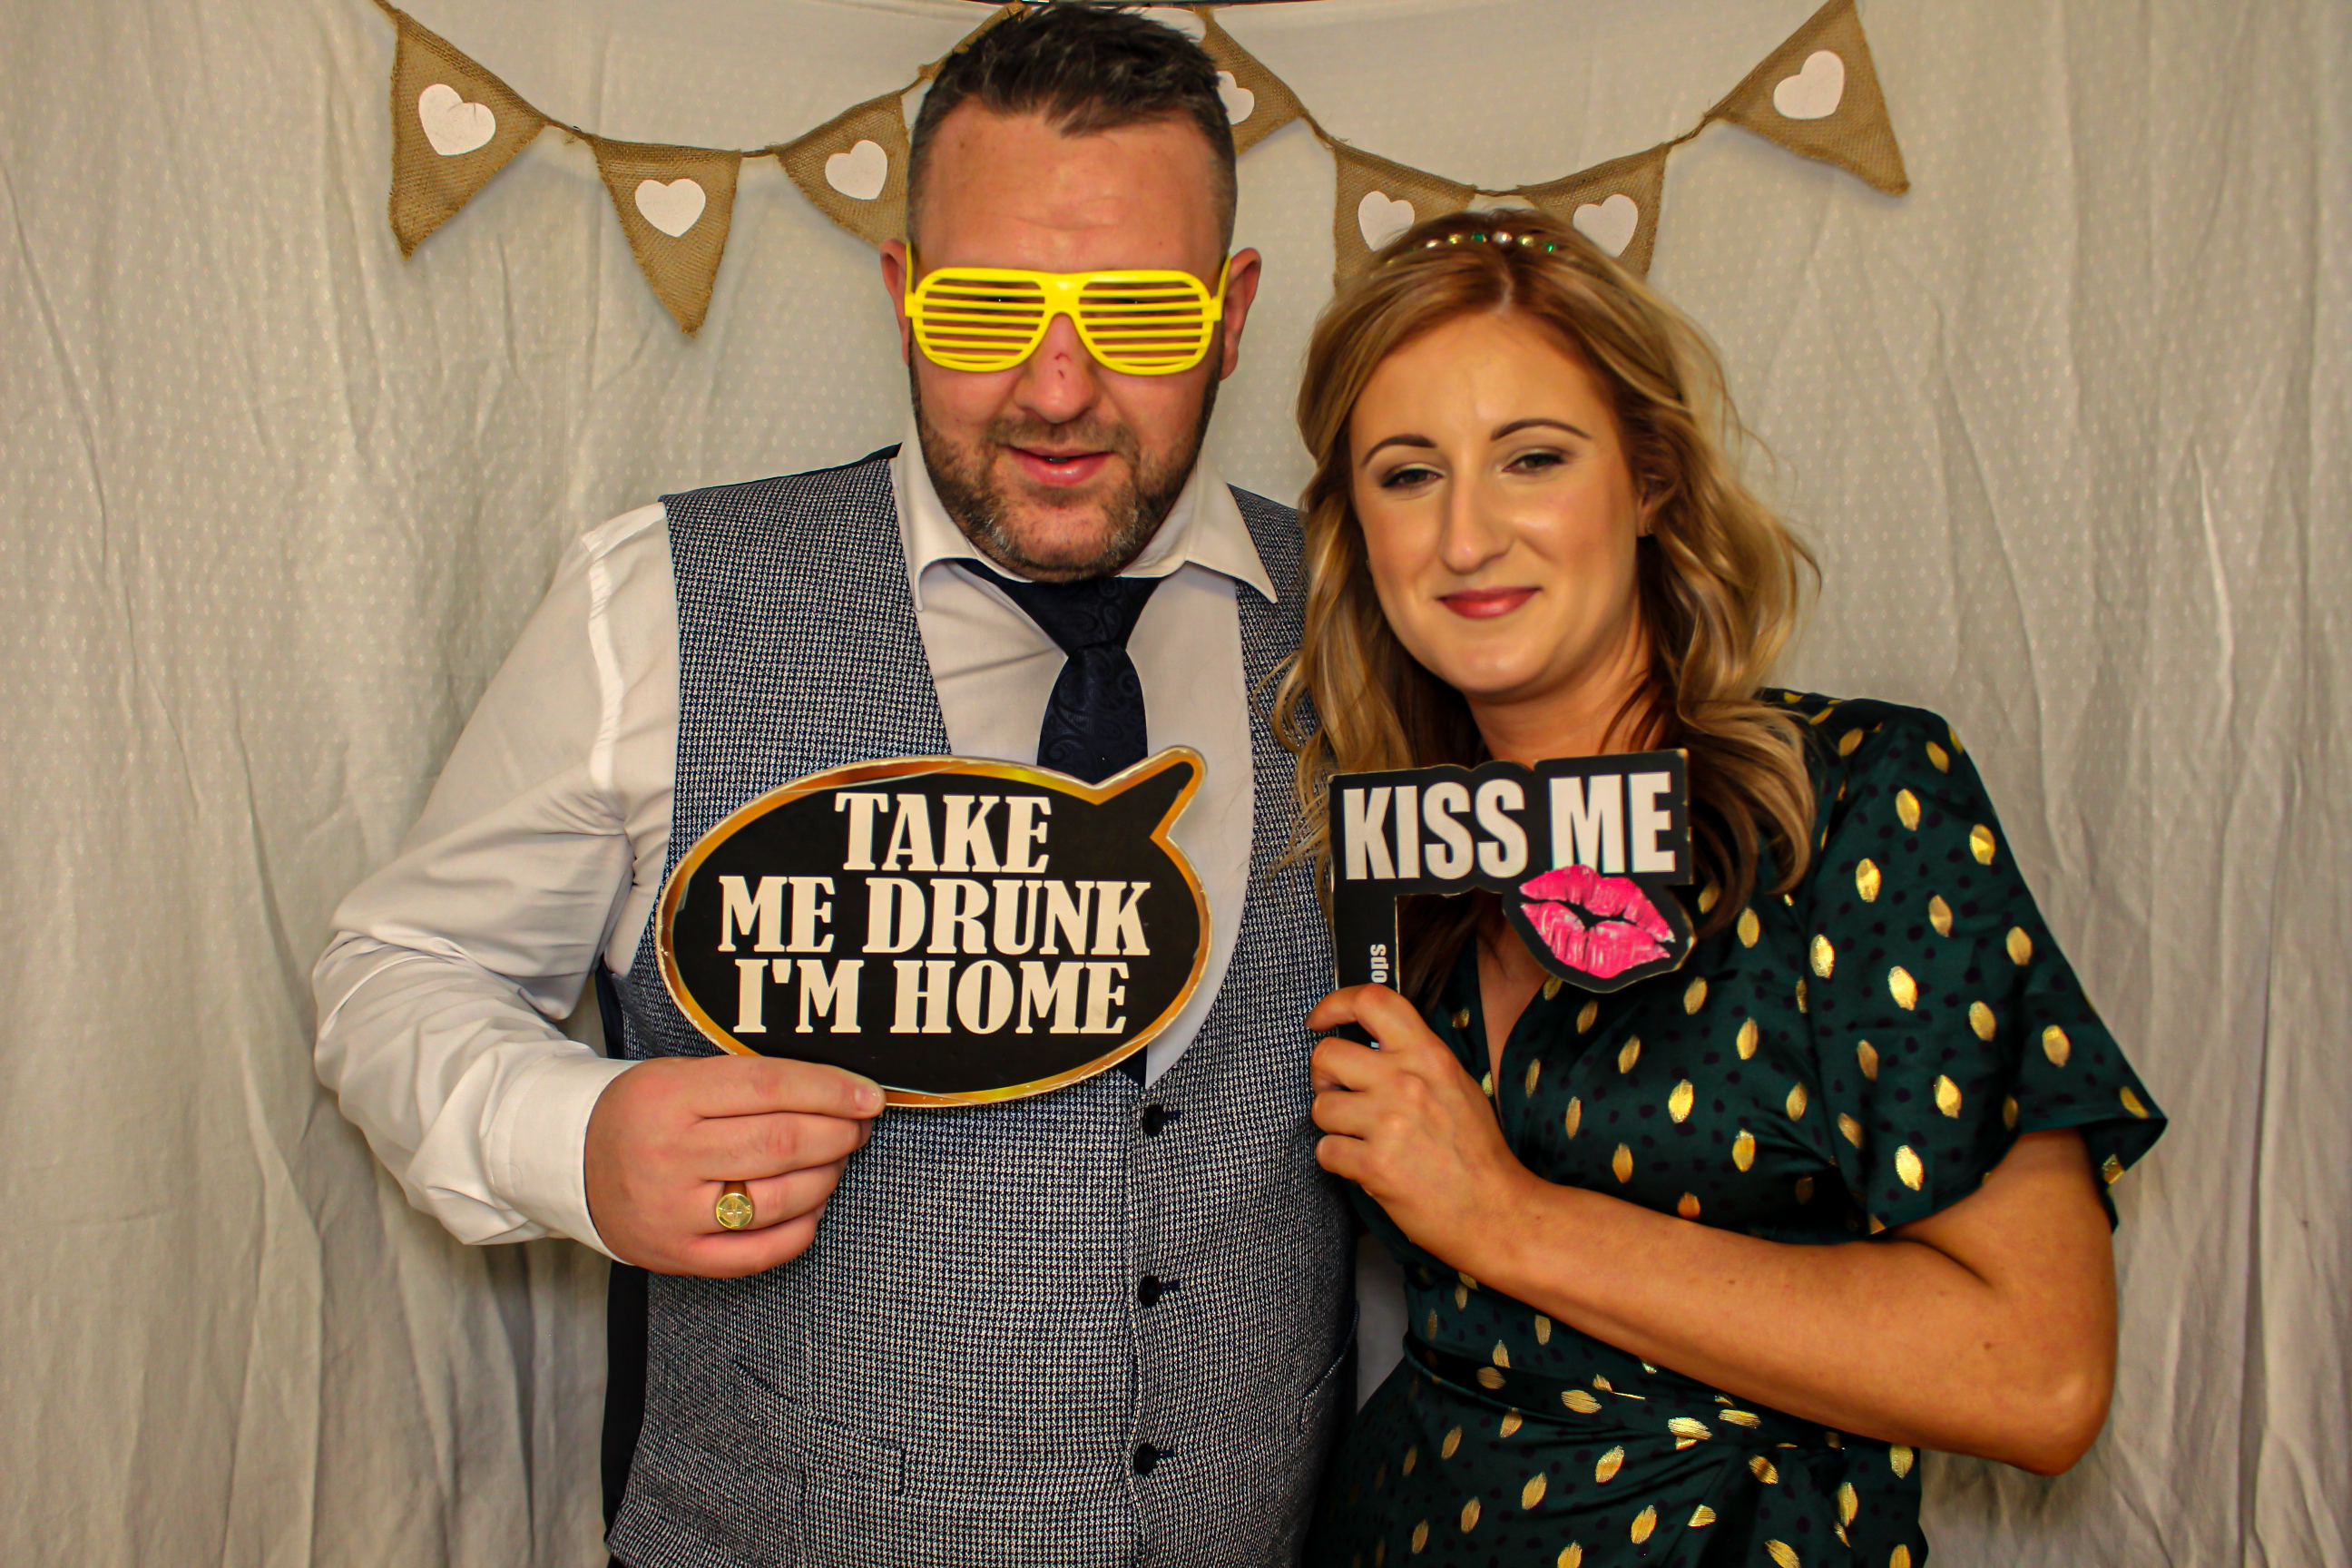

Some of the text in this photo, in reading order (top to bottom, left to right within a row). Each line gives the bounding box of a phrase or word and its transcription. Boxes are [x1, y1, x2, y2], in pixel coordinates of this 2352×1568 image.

[835, 792, 1053, 874] TAKE
[1343, 771, 1675, 880] KISS ME
[718, 876, 1151, 956] ME DRUNK
[733, 958, 1130, 1034] I'M HOME
